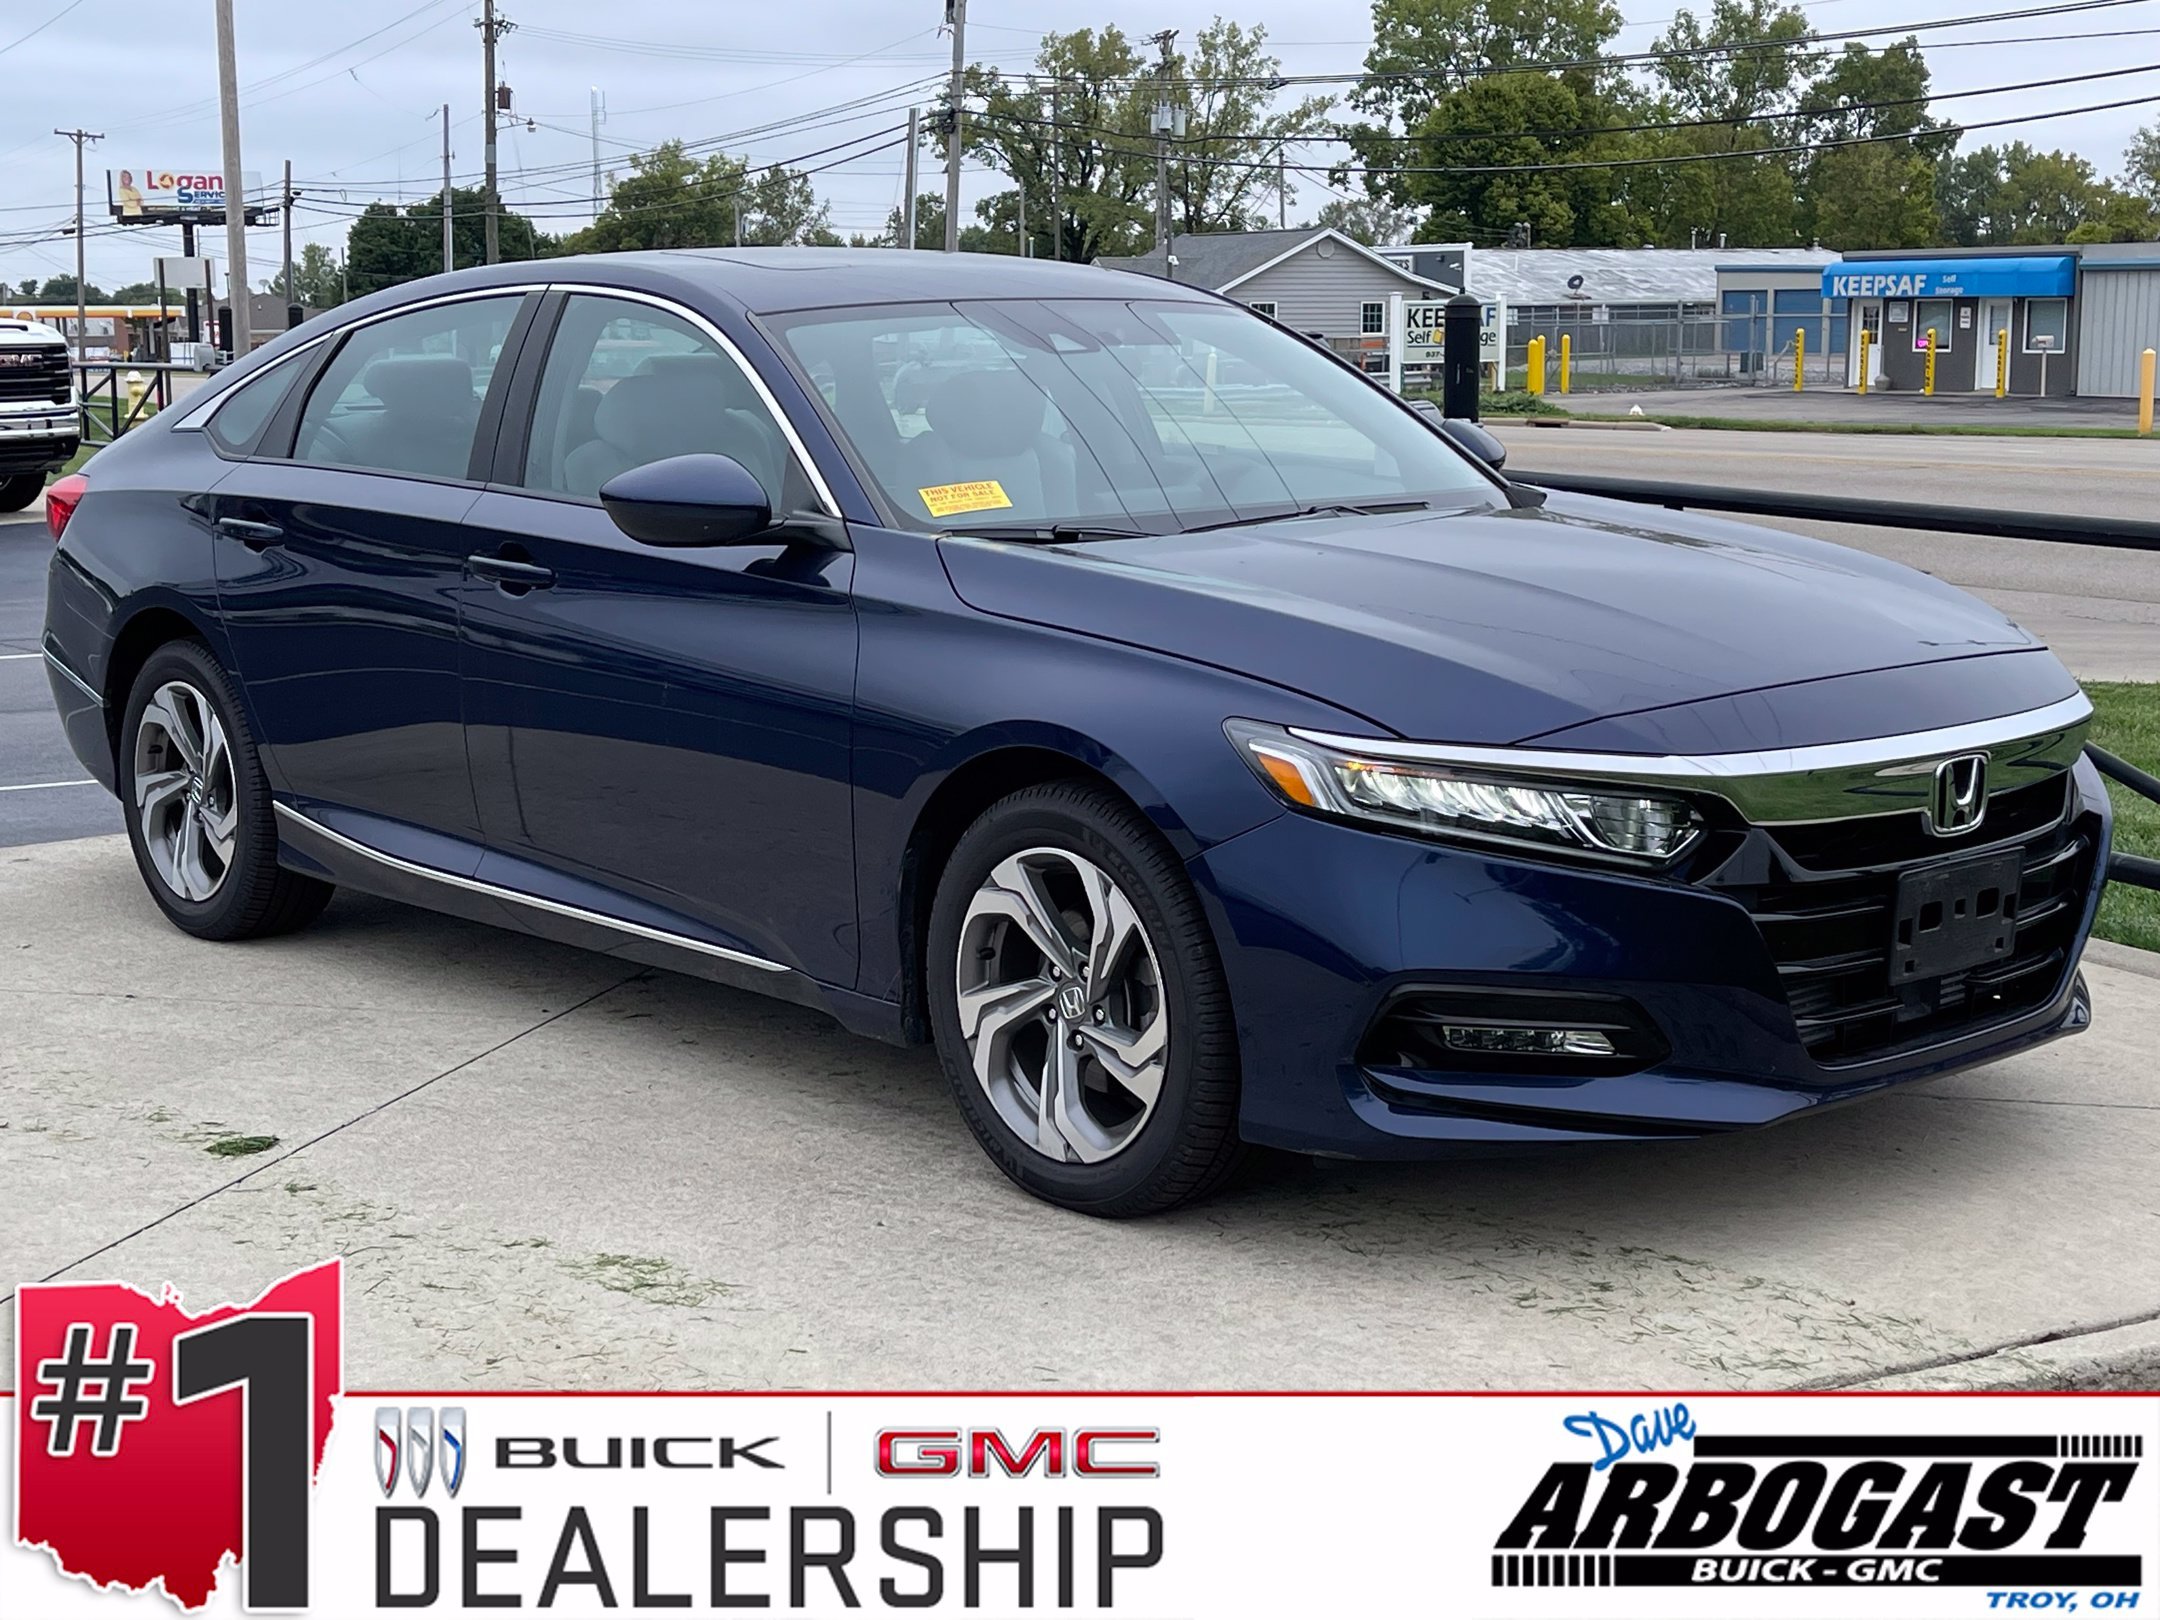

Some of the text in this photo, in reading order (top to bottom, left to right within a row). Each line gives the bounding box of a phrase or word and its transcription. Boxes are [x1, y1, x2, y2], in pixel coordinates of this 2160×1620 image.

[146, 170, 223, 191] Logan
[1832, 274, 1927, 297] KEEPSAF
[1935, 286, 1964, 296] Storage
[1407, 331, 1432, 344] Self
[924, 482, 995, 498] THIS VEHICLE
[930, 494, 949, 503] NOT
[952, 492, 970, 500] FOR
[972, 489, 995, 497] SALE
